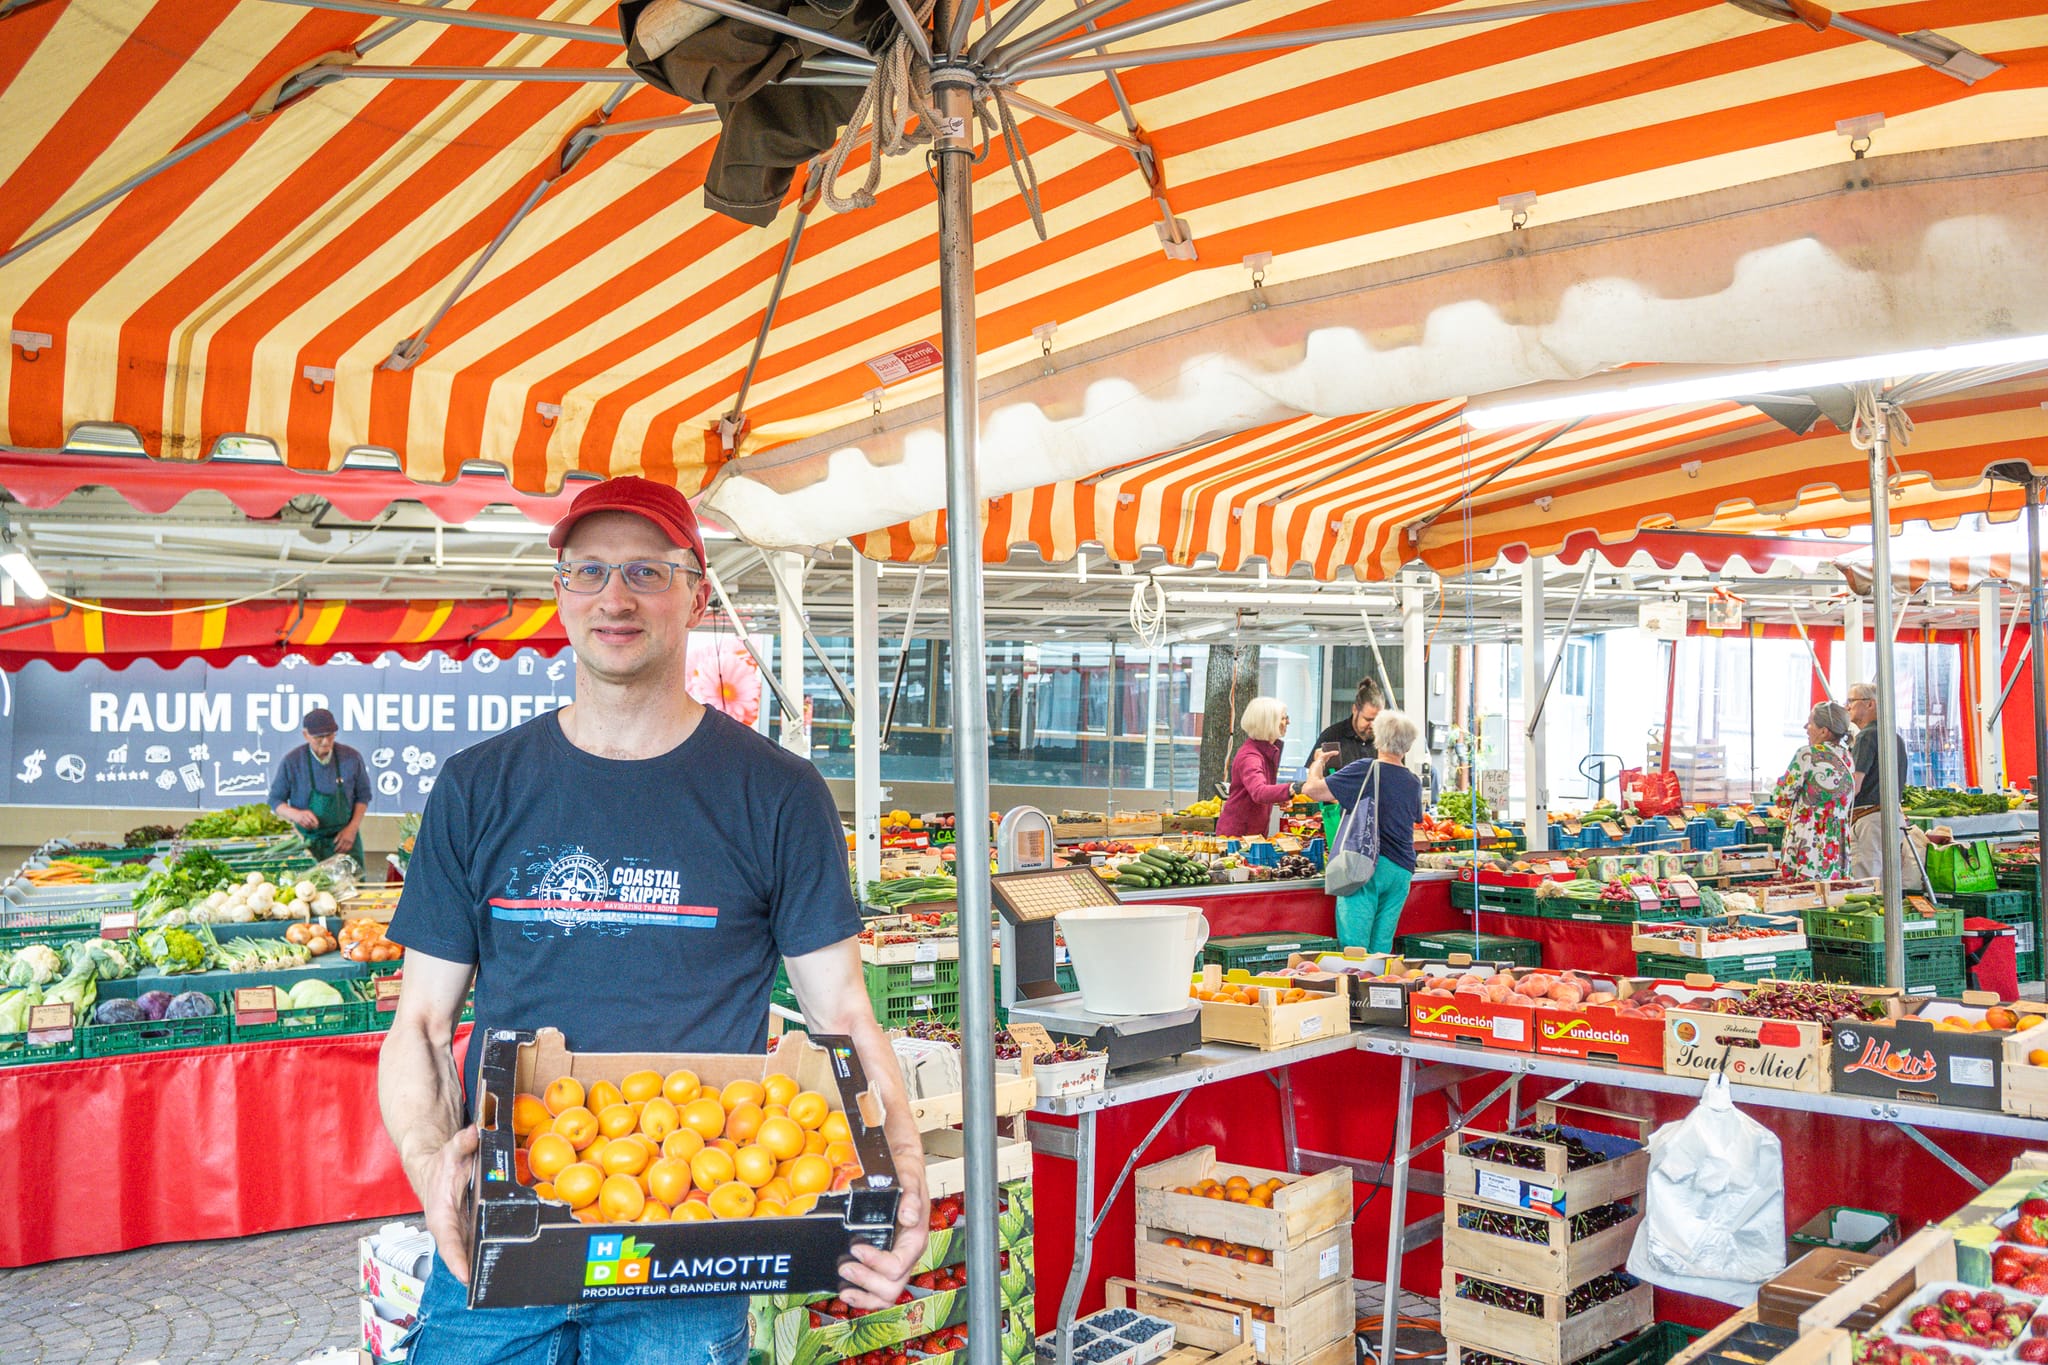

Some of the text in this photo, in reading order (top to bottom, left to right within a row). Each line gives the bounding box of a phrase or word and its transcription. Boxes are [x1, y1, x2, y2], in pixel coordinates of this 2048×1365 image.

[90, 692, 231, 732] RAUM
[343, 694, 455, 732] NEUE
[468, 696, 577, 732] IDE
[612, 867, 681, 889] COASTAL
[619, 887, 680, 906] SKIPPER
[1749, 1052, 1808, 1080] Miel
[653, 1254, 792, 1279] LAMOTTE
[582, 1279, 788, 1299] PRODUCTEUR GRANDEUR NATURE
